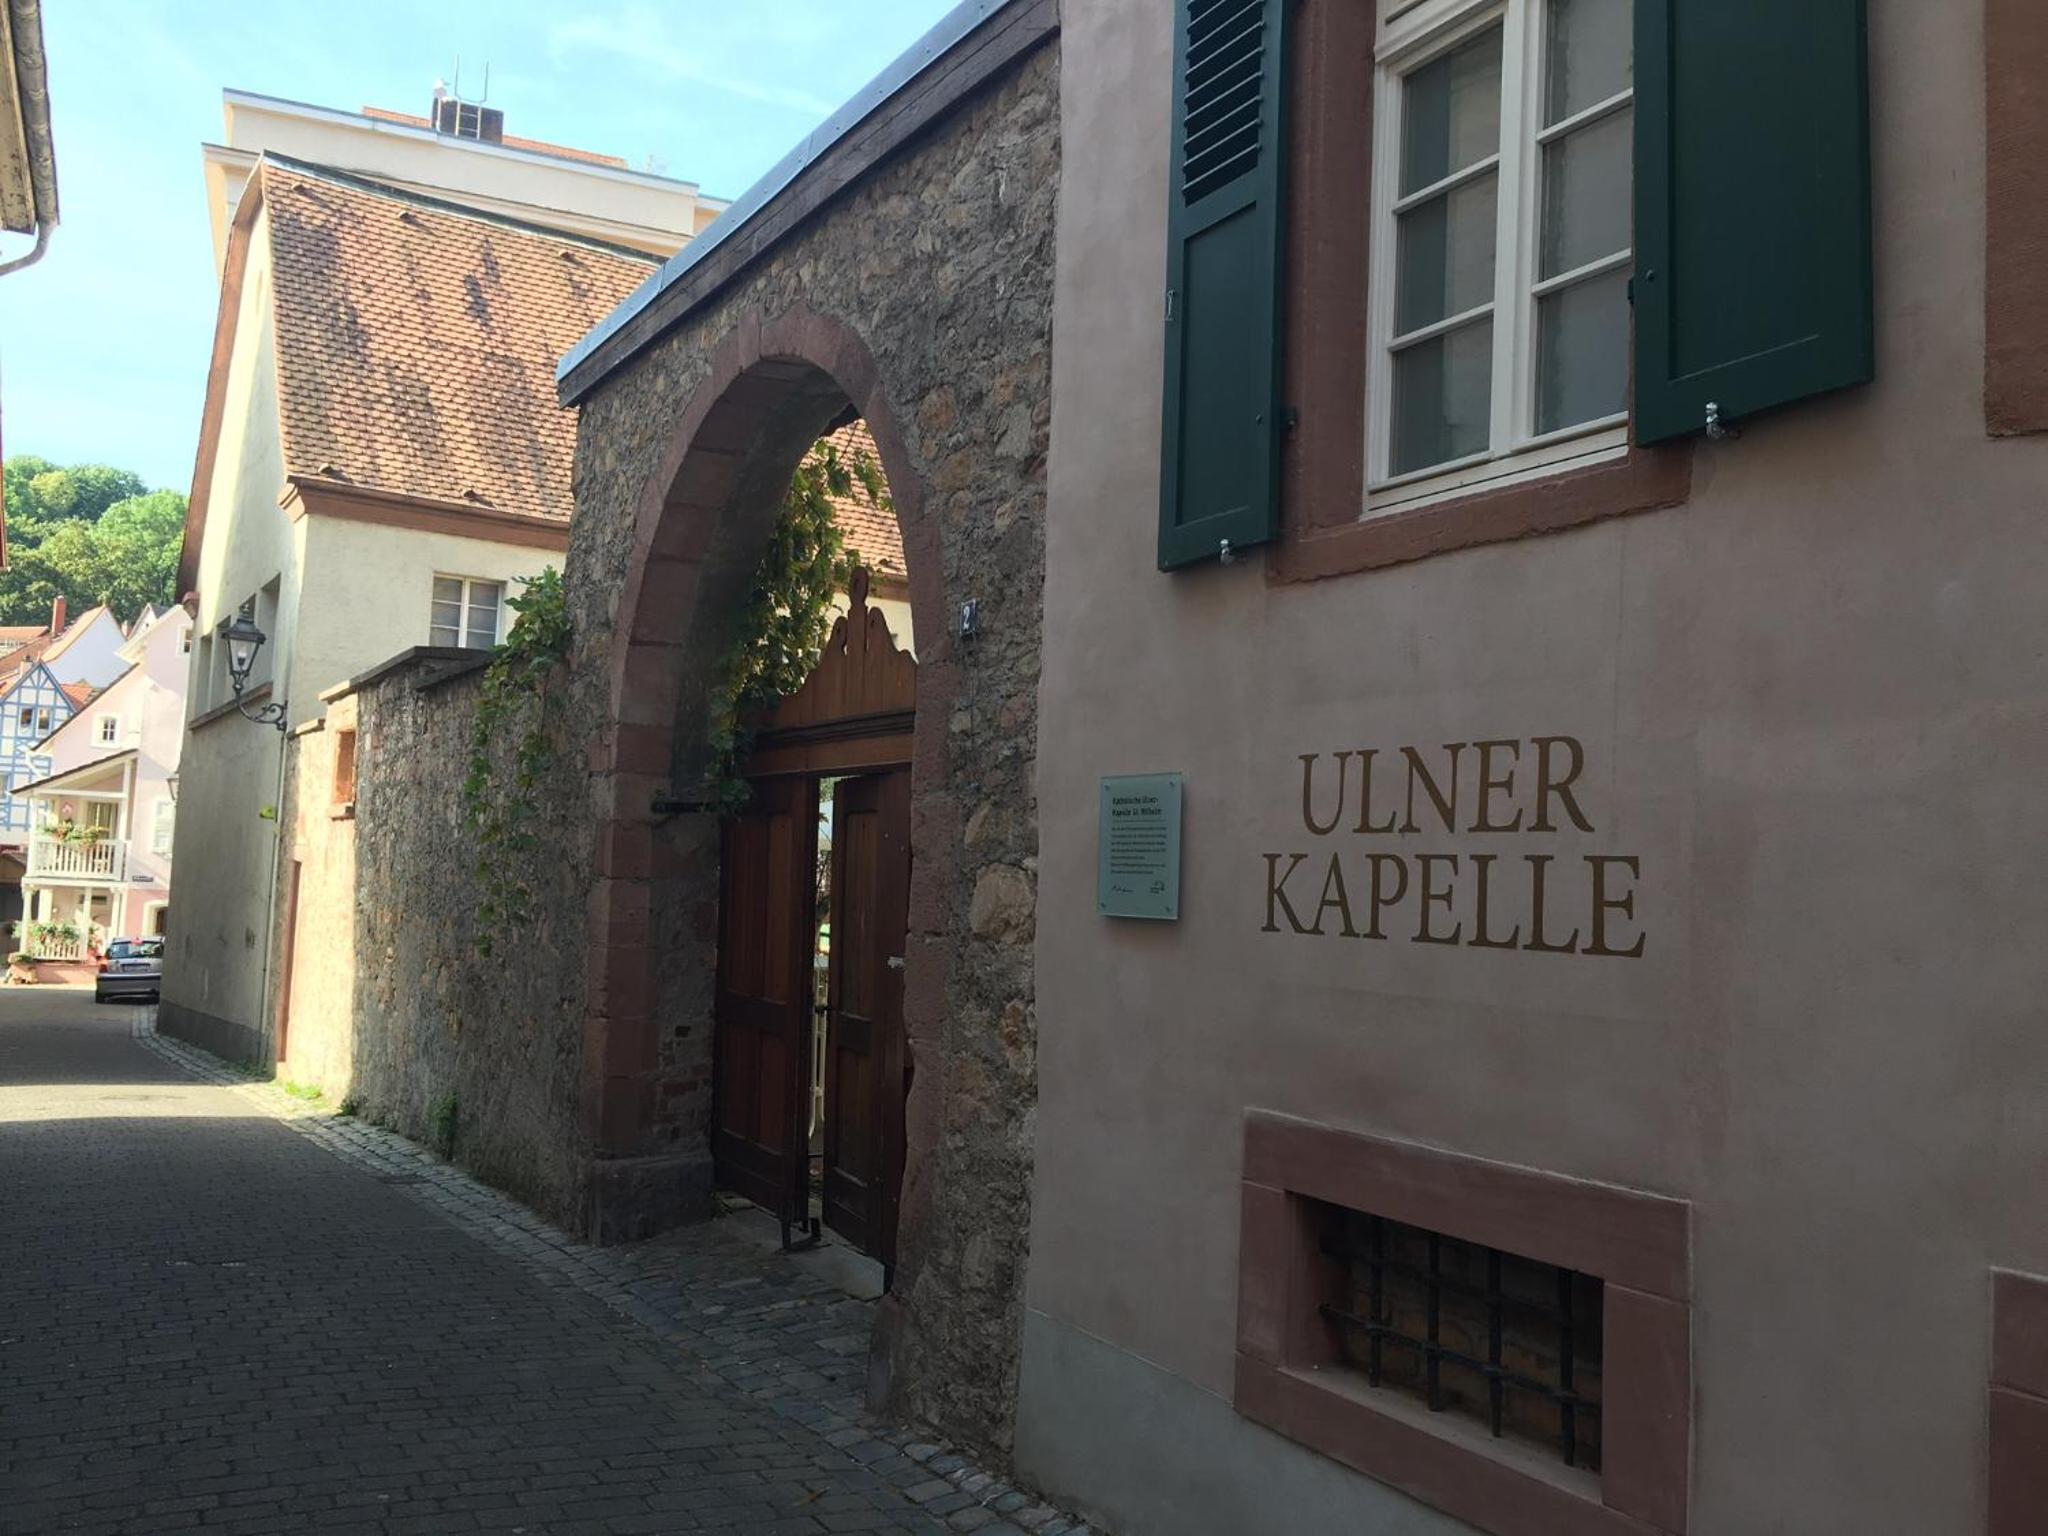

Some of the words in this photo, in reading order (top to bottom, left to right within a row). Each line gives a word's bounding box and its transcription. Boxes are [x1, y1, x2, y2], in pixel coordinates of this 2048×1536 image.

[963, 605, 970, 630] 2
[1298, 735, 1595, 836] ULNER
[1260, 852, 1646, 958] KAPELLE
